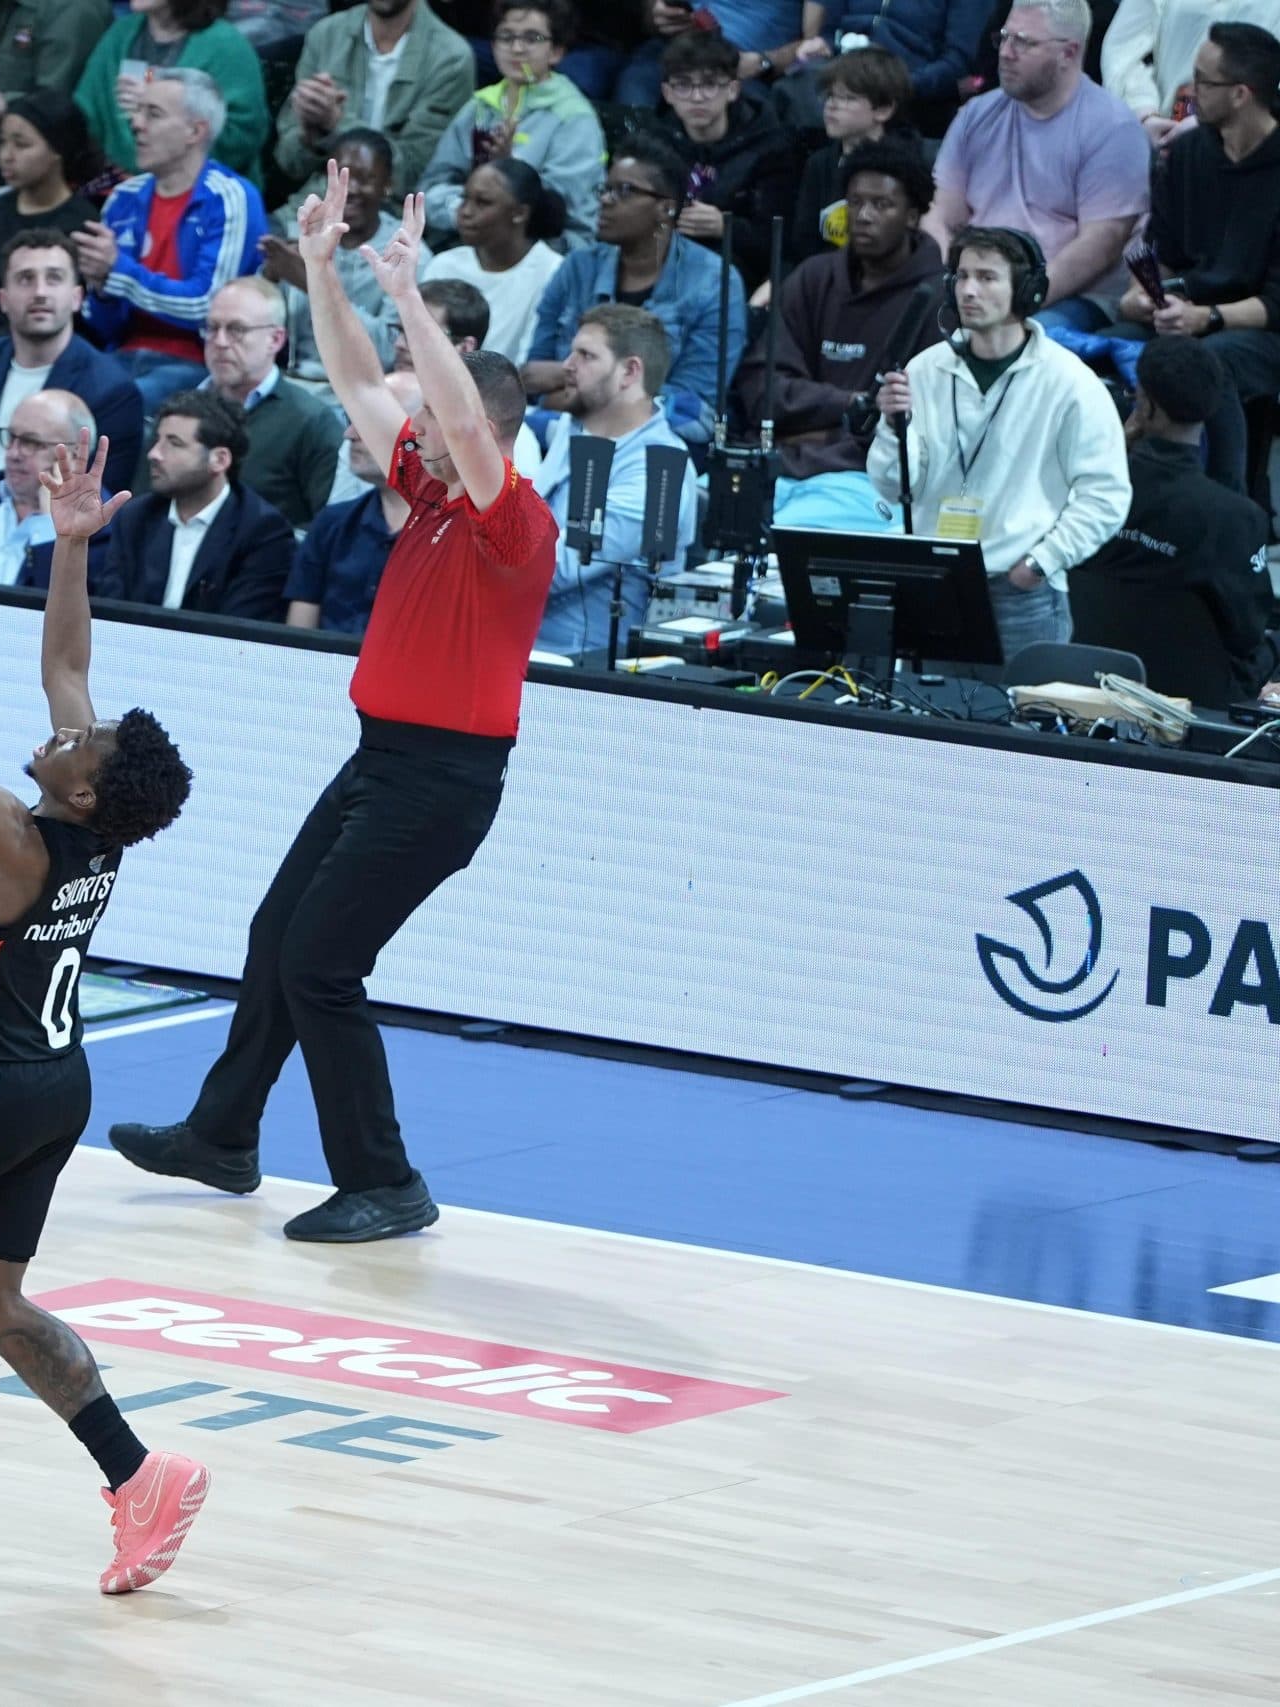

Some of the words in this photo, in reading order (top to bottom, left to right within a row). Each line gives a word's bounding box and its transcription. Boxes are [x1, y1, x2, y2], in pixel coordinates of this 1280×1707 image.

[52, 871, 116, 911] SHORTS
[41, 946, 80, 1050] 0
[1146, 905, 1280, 1025] PA
[49, 1297, 672, 1414] Betclic
